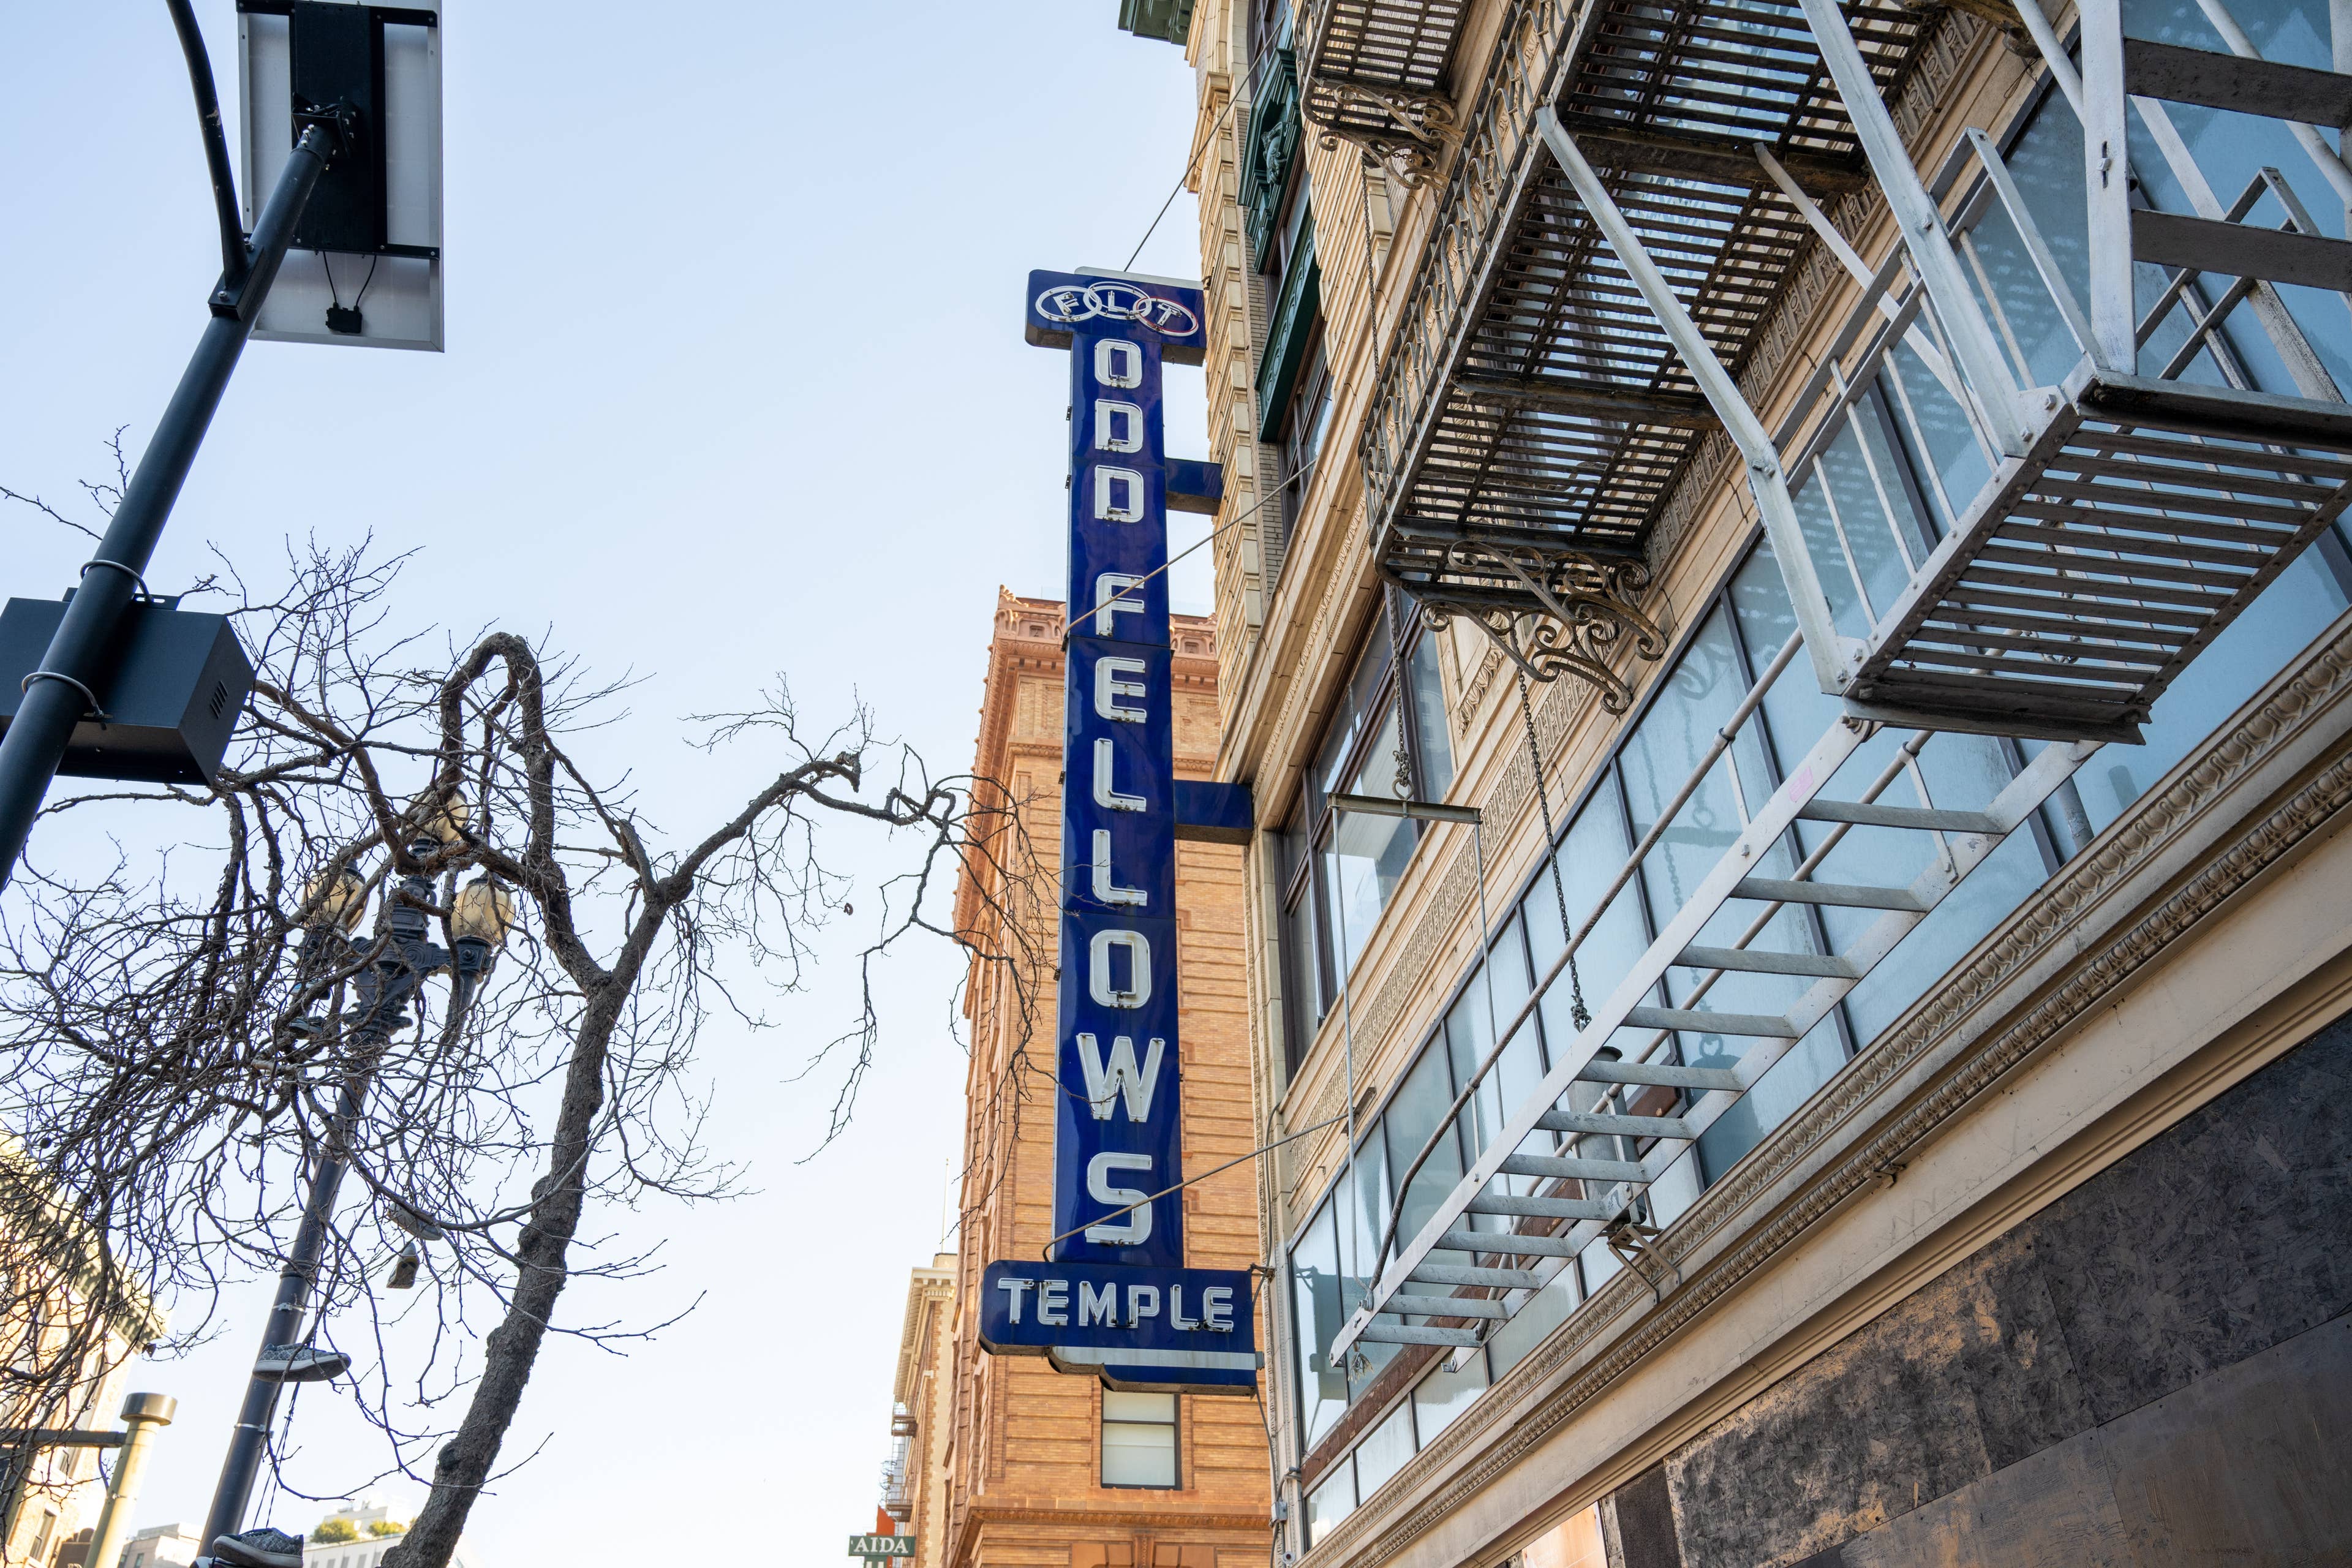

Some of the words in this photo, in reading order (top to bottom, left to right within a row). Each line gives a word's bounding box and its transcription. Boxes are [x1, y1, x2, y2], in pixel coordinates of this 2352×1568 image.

[1095, 338, 1144, 522] ODD
[1076, 572, 1165, 1245] FELLOWS
[998, 1278, 1234, 1332] TEMPLE
[854, 1537, 908, 1553] AIDA
